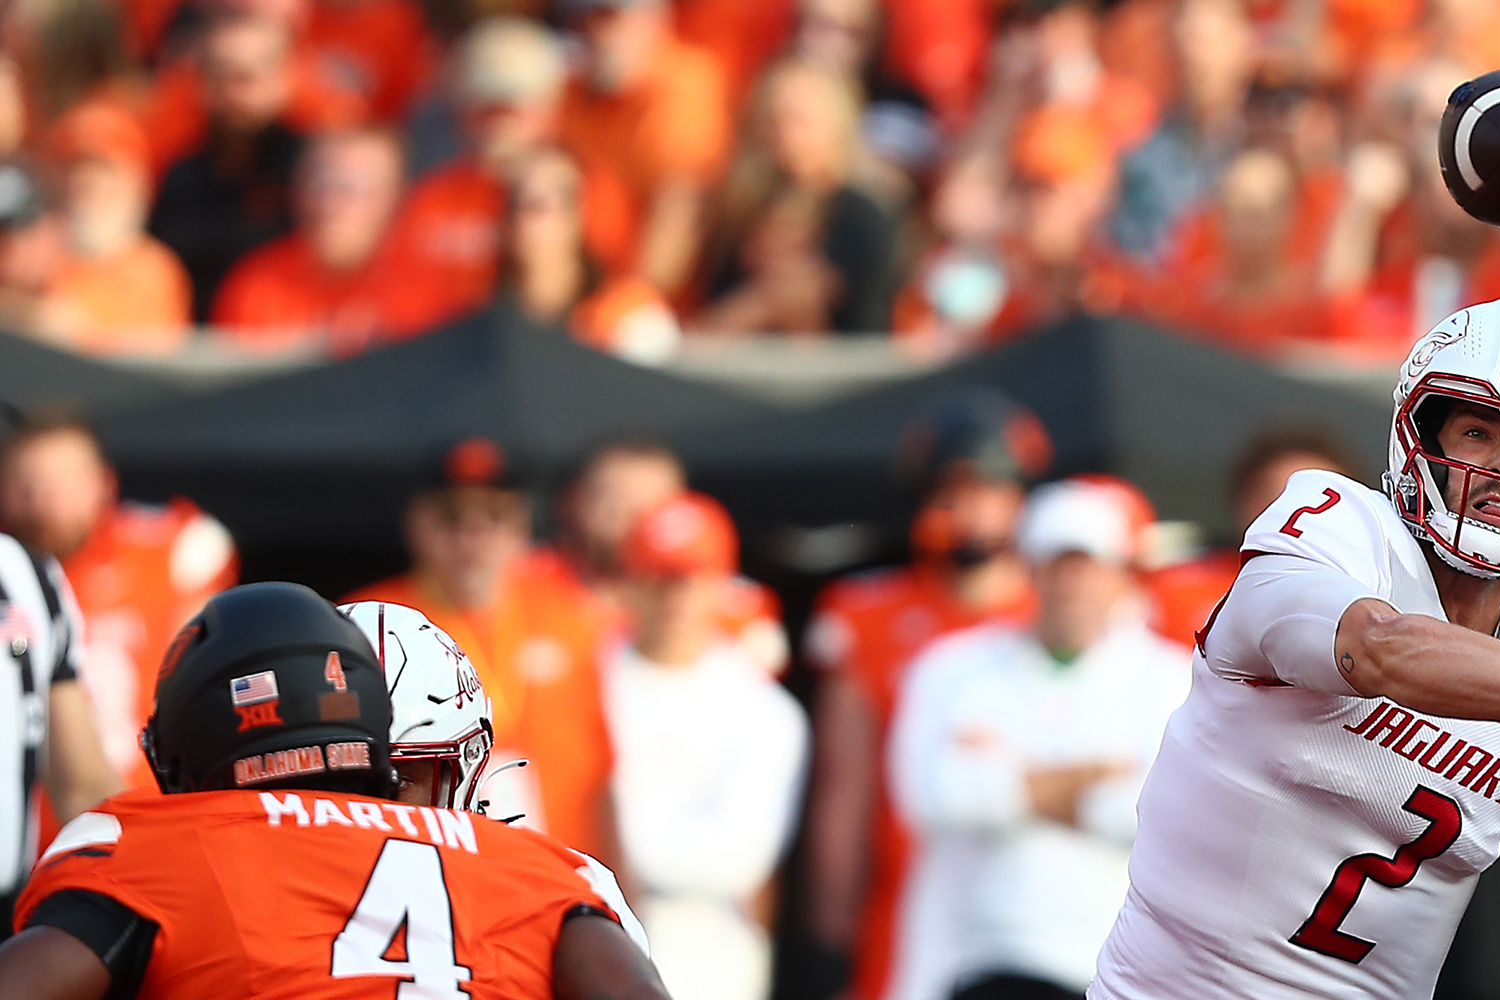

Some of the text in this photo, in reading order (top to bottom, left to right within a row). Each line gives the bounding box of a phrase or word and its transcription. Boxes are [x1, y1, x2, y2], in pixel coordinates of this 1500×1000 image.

[1279, 487, 1341, 538] 2
[325, 651, 347, 690] 4
[234, 741, 371, 787] OKLAHOMA STATE
[258, 792, 478, 854] MARTIN
[1288, 784, 1462, 965] 2
